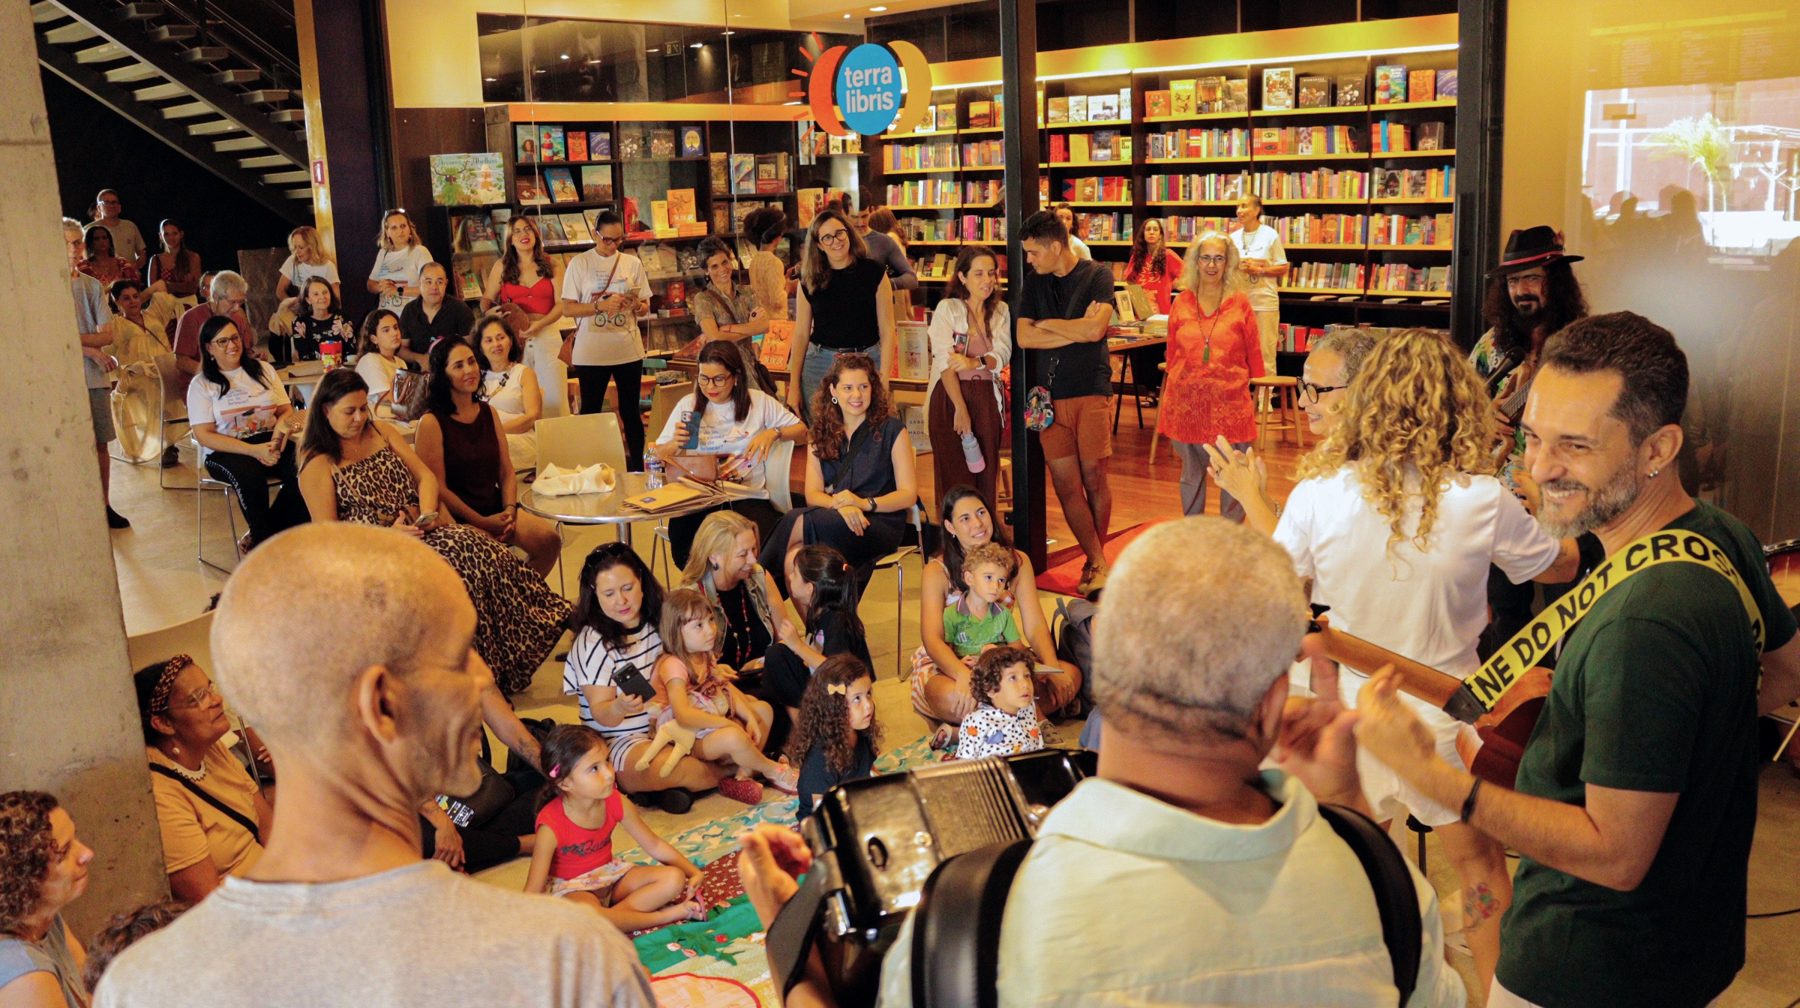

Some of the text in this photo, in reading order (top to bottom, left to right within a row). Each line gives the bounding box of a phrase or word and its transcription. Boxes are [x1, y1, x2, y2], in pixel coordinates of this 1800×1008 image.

[844, 66, 893, 88] terra
[845, 87, 895, 114] libris
[1473, 533, 1739, 702] NE DO NOT CROS
